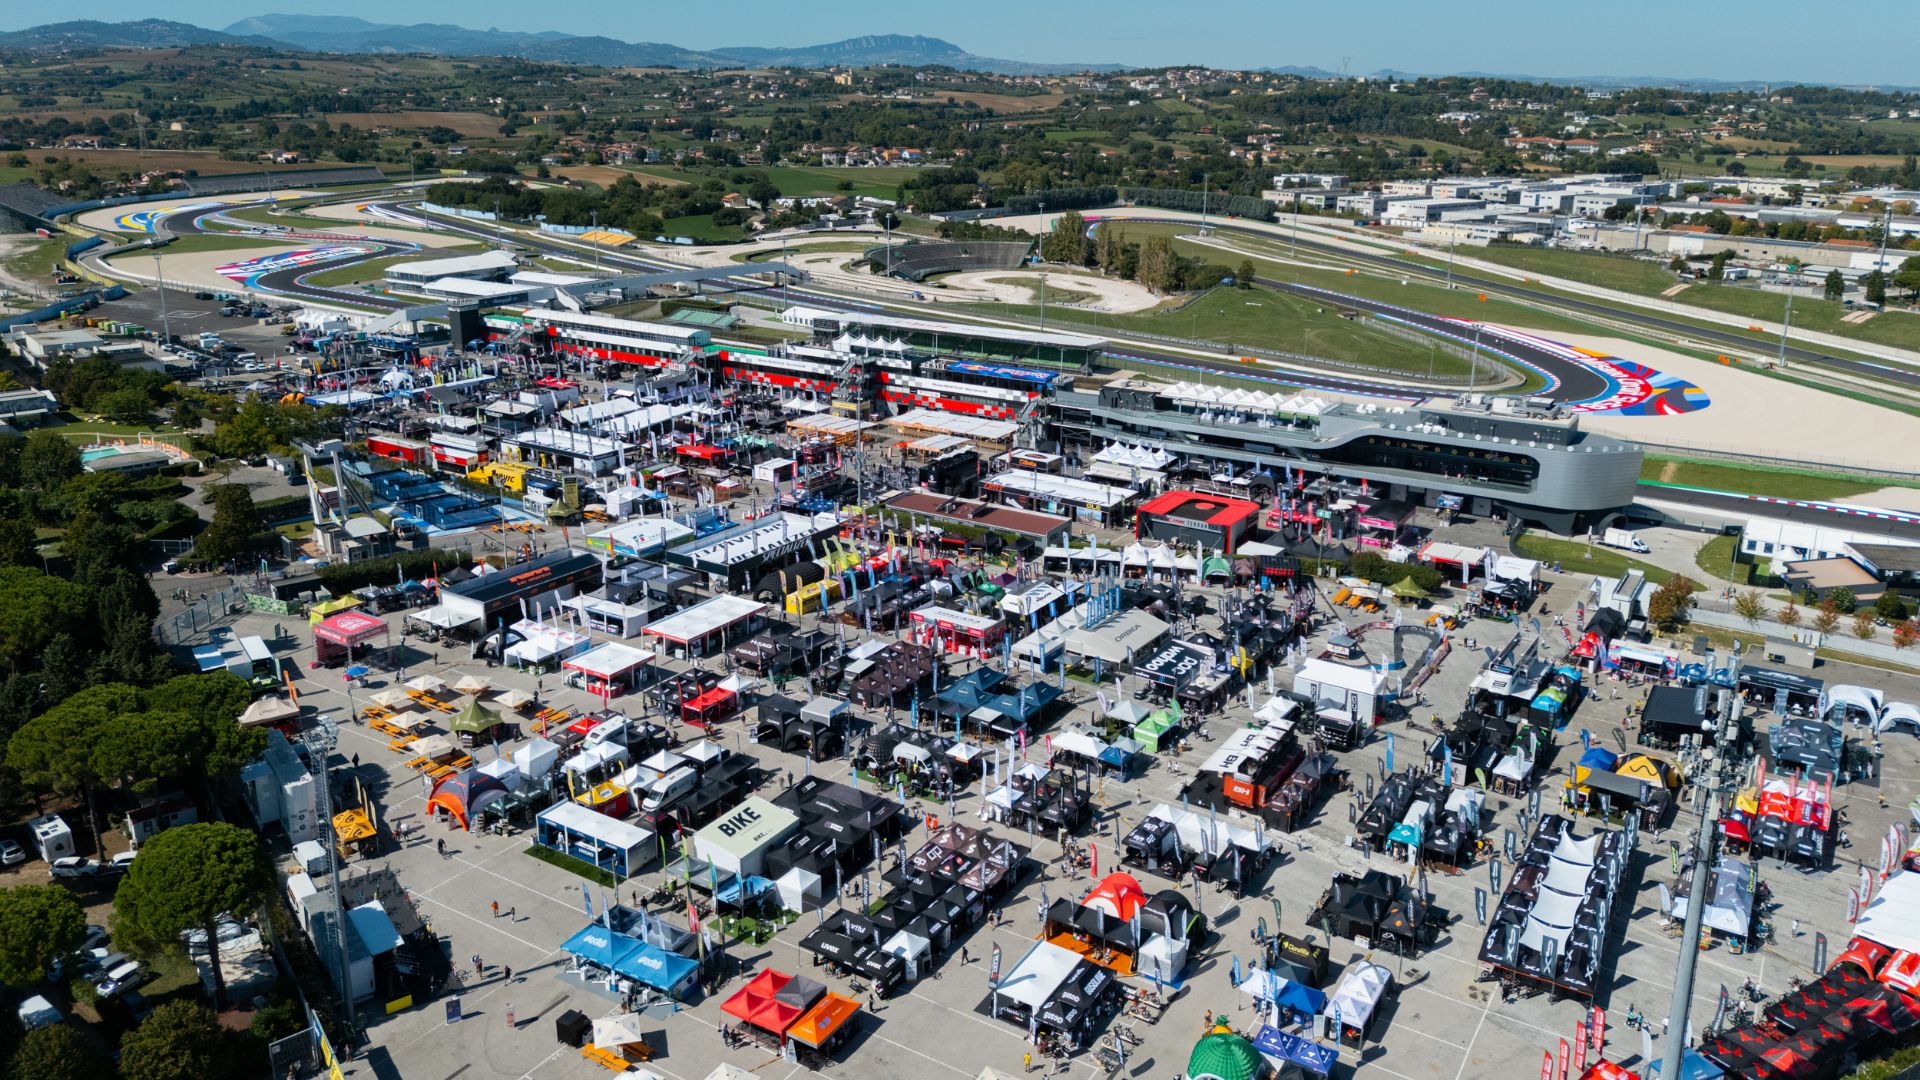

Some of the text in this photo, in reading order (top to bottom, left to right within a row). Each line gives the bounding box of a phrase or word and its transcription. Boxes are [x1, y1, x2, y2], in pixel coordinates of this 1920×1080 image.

[1114, 623, 1142, 643] ORBEA
[750, 639, 772, 649] HEAD
[735, 647, 759, 657] HEAD
[1233, 785, 1250, 796] BH
[717, 806, 762, 838] BIKE
[821, 942, 840, 954] uvex
